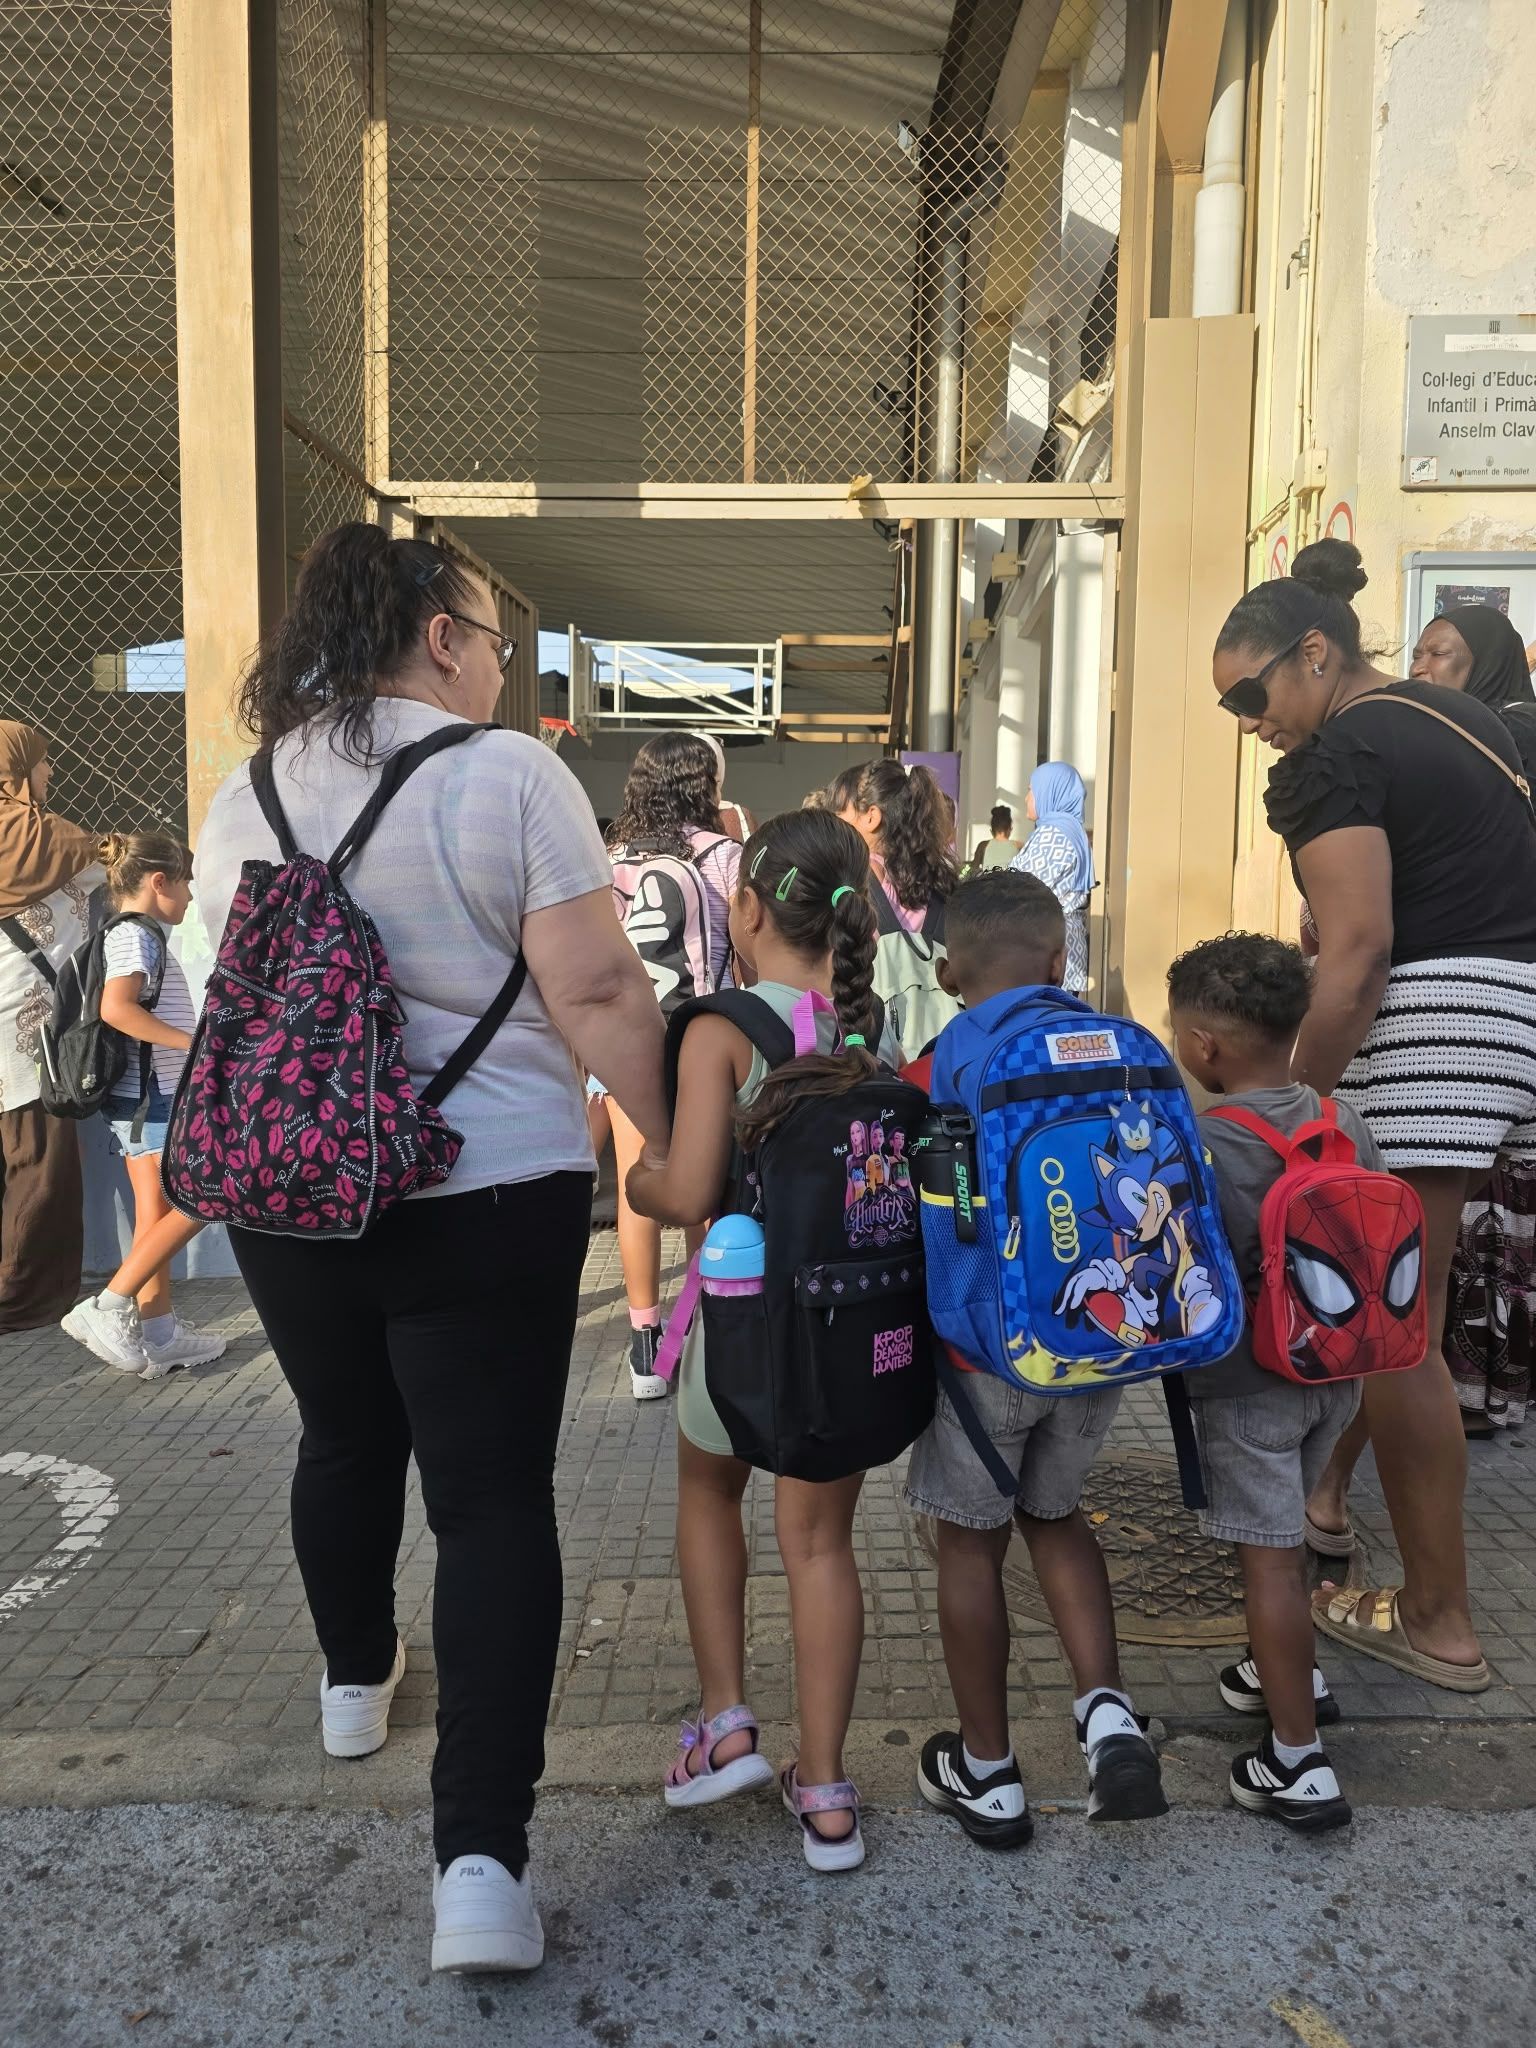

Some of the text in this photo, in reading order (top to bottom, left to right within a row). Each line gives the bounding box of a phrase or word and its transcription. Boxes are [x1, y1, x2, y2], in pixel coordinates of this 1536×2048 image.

[1422, 371, 1536, 391] Col·legi d'Educa
[1427, 396, 1536, 413] Infantil i Primà
[1439, 421, 1536, 438] Anselm Clav
[1056, 1033, 1112, 1052] SONIC
[283, 1110, 312, 1132] Penelope
[284, 1119, 315, 1145] Charmosa
[339, 1154, 370, 1177] Penelope
[955, 1161, 972, 1223] SPORT
[873, 1335, 913, 1363] DEMON
[873, 1352, 913, 1378] HUNTERS
[343, 1690, 363, 1699] FILA
[459, 1866, 485, 1878] FILA
